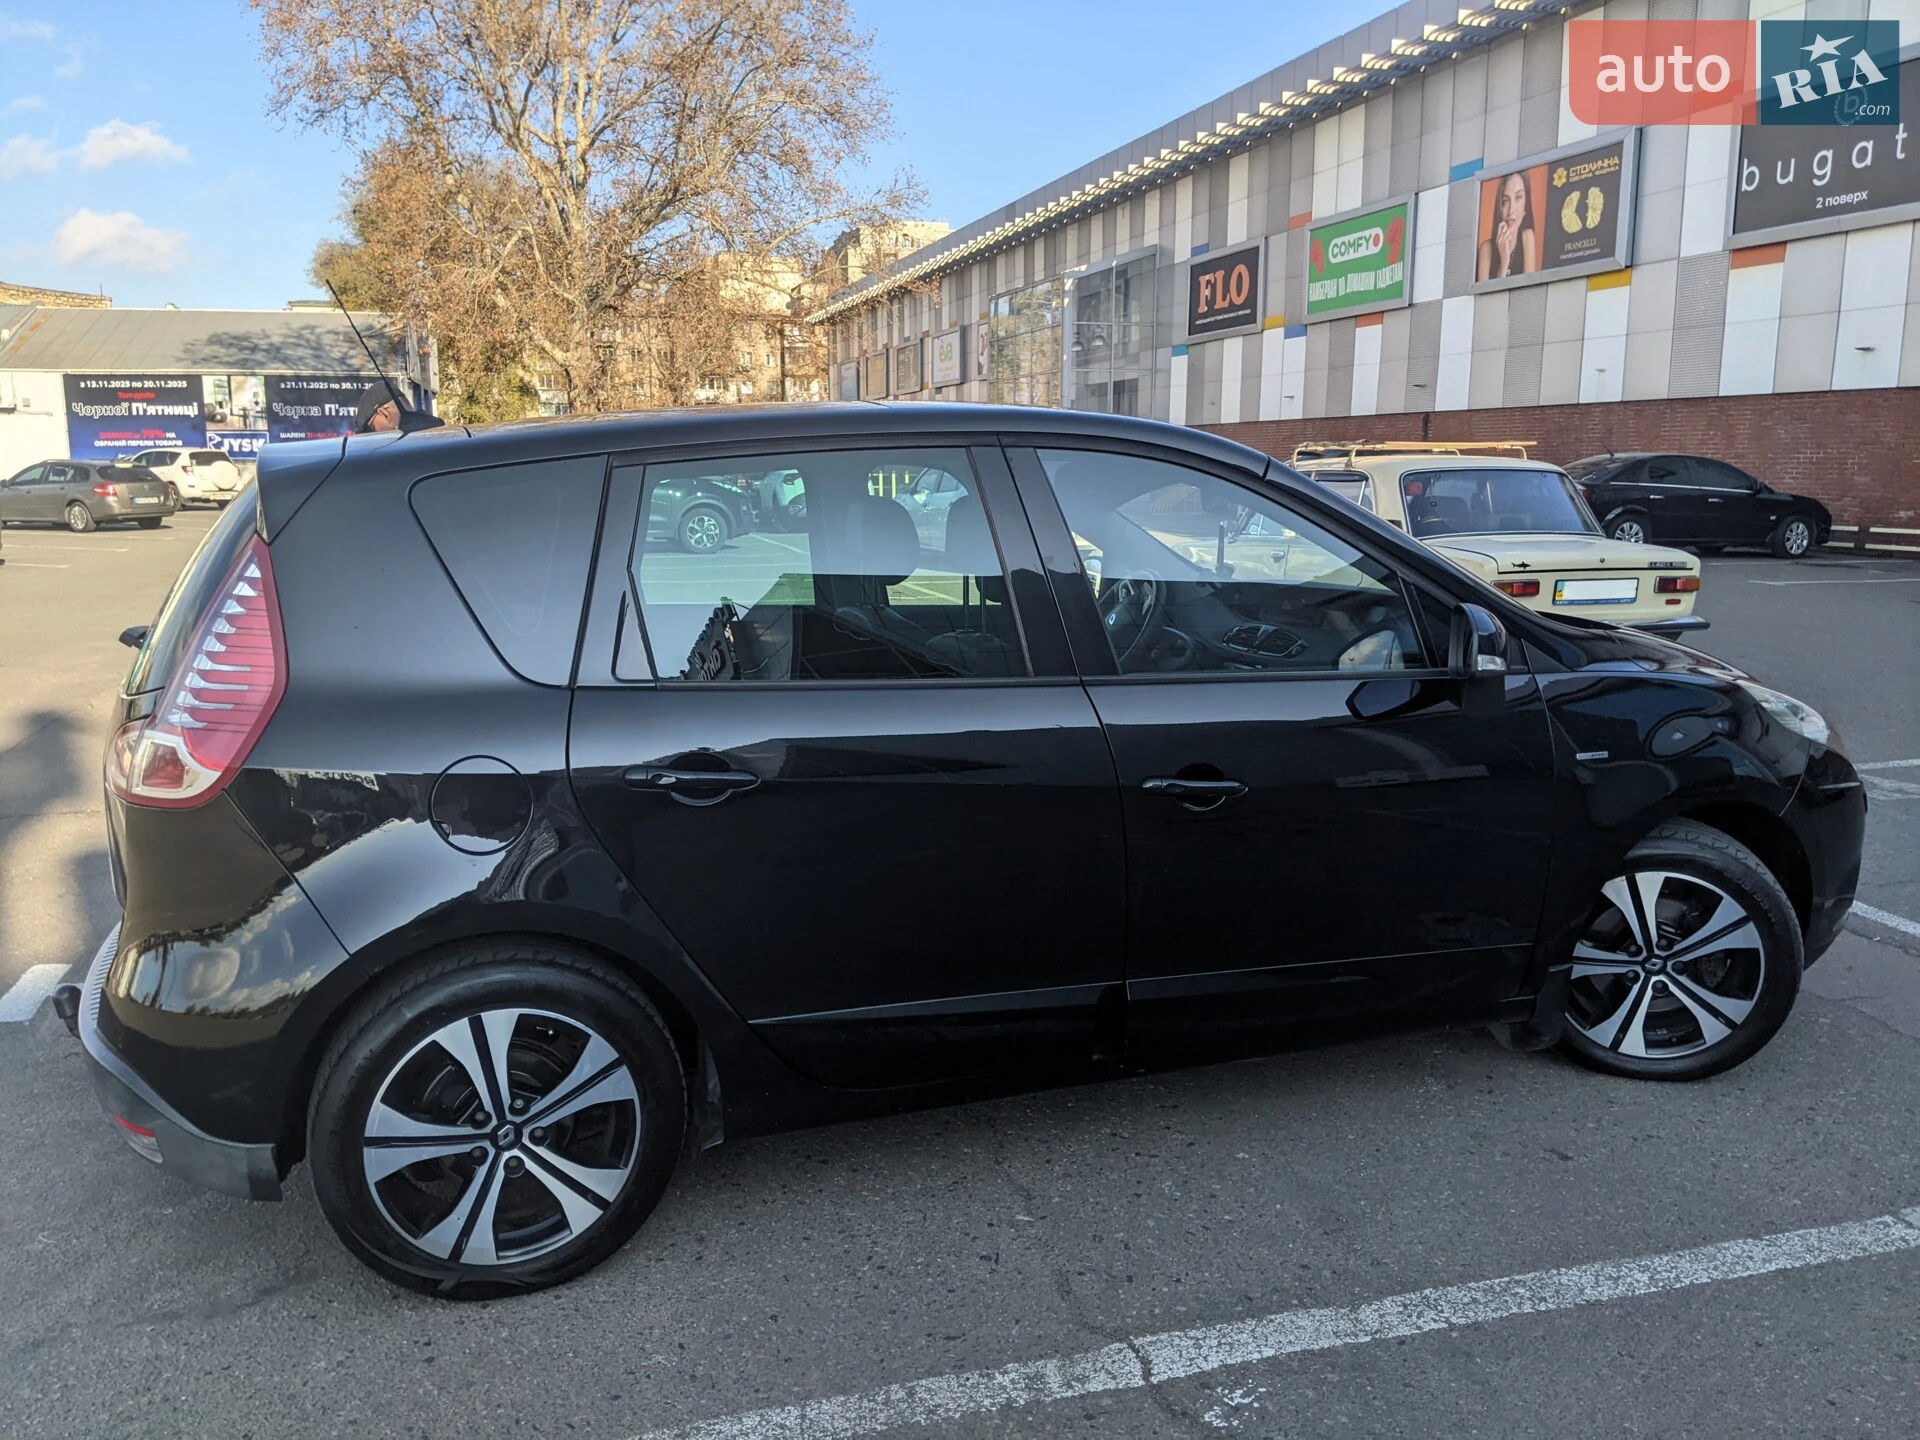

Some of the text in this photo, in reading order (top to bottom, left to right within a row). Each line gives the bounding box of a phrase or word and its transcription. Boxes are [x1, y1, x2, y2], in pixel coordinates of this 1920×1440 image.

[1569, 156, 1620, 177] СТОЛИЧНА
[1741, 123, 1907, 192] bugat
[1815, 190, 1868, 209] 2 поверх
[1331, 233, 1372, 259] COMFY
[1197, 263, 1250, 314] FLO
[86, 380, 130, 388] 13.11.2025
[143, 380, 187, 388] 20.11.2025
[286, 381, 328, 389] 21.11.2025
[72, 401, 199, 418] Чорної П'ятниці
[272, 402, 358, 418] Чорна П'ят
[221, 438, 266, 452] JYSK
